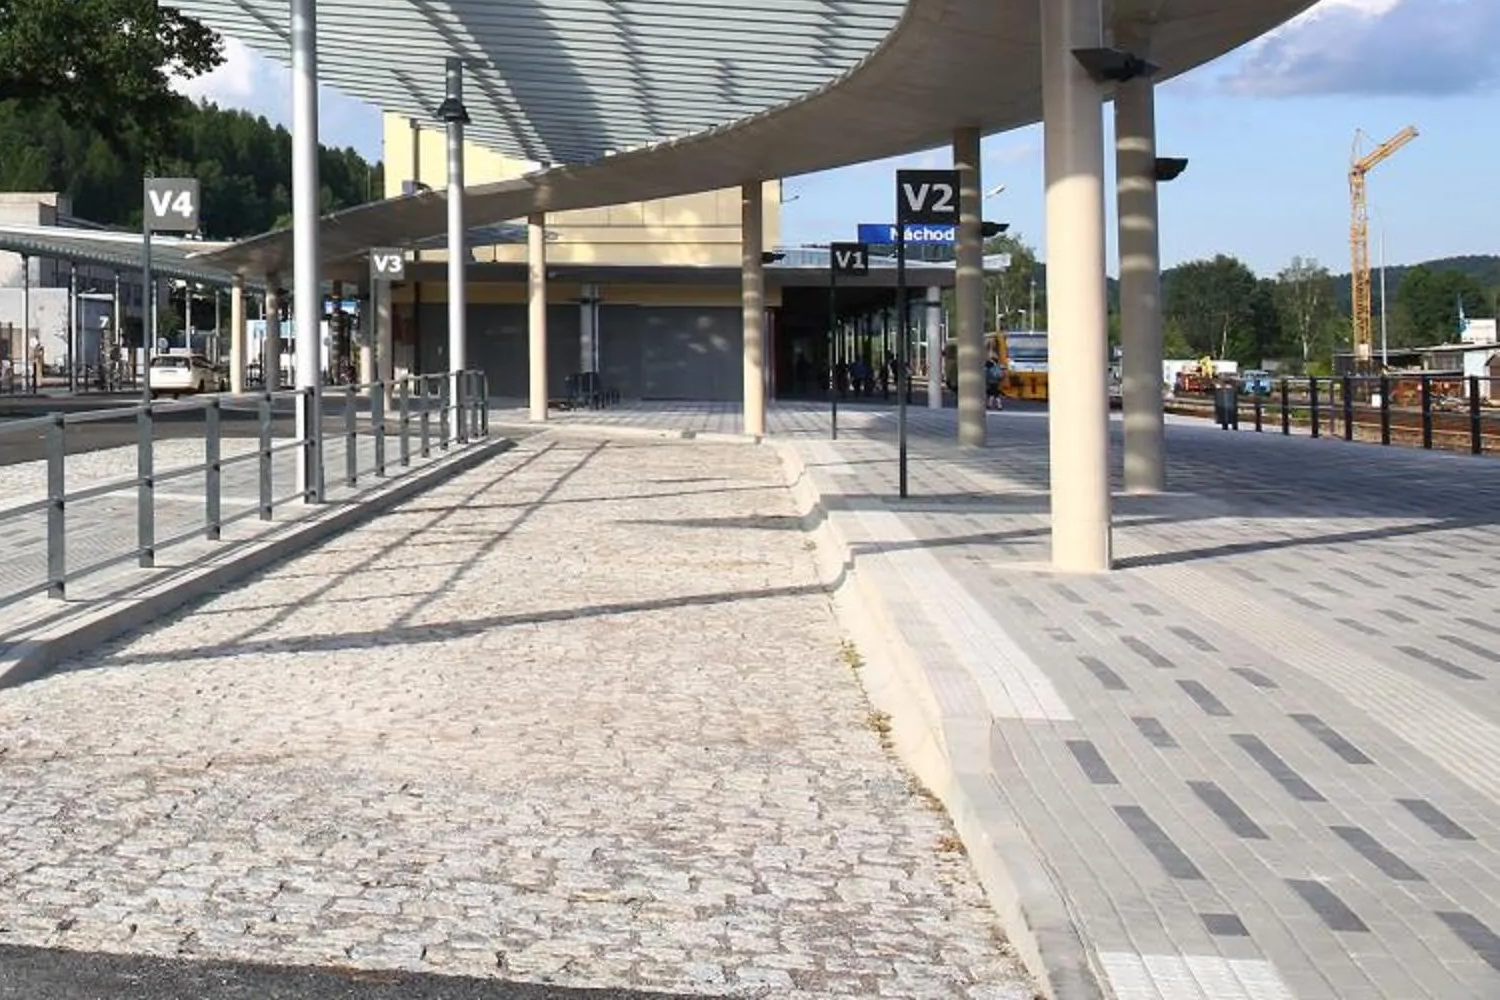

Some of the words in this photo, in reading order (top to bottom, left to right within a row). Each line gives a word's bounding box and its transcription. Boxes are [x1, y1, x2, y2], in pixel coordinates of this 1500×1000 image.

[148, 189, 194, 217] V4
[903, 183, 955, 212] V2
[373, 255, 402, 273] V3
[836, 251, 865, 269] V1
